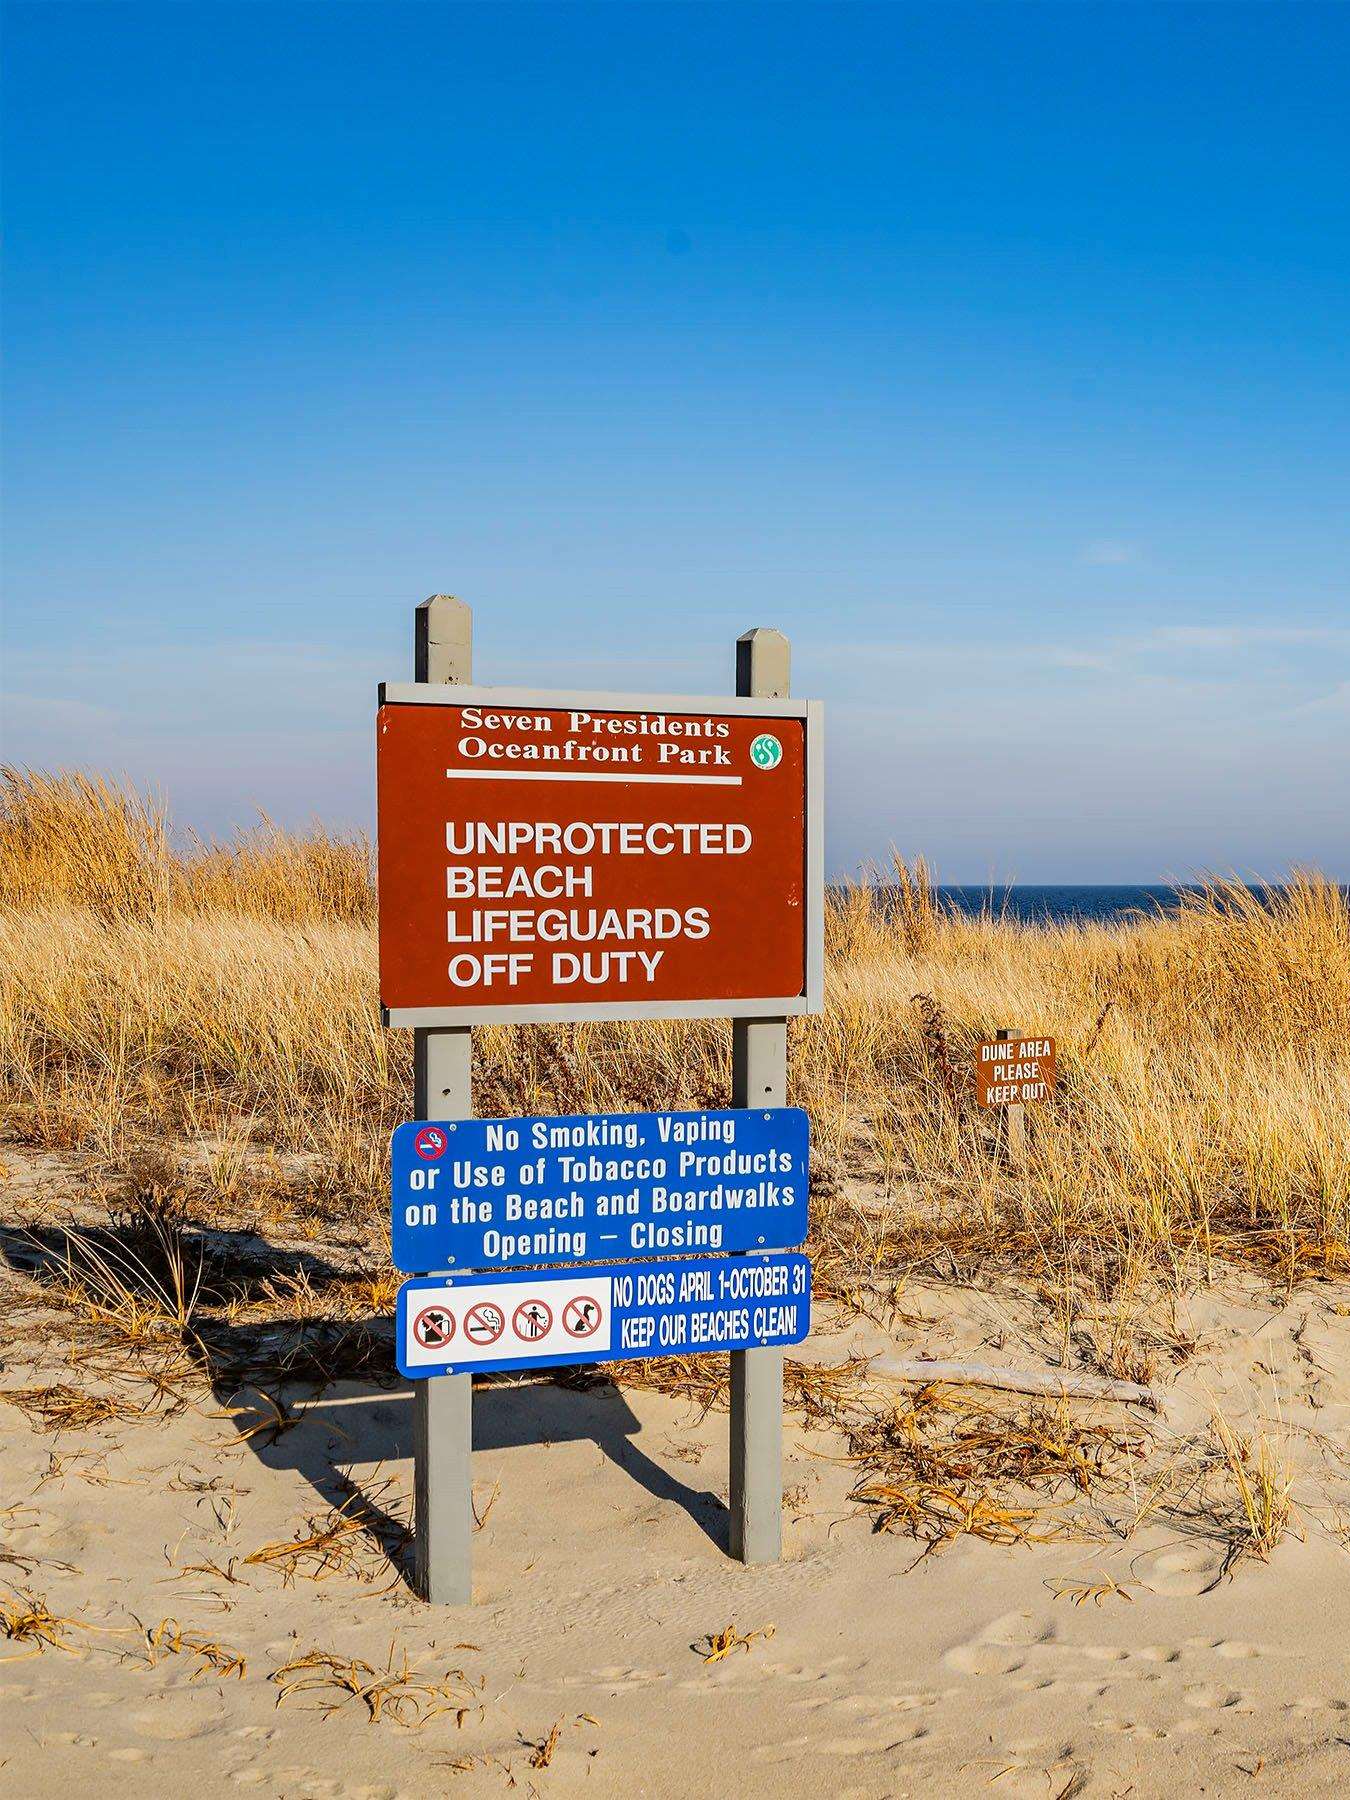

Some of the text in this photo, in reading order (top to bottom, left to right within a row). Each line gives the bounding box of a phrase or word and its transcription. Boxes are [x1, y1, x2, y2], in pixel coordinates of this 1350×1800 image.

[460, 708, 729, 737] Seven Presidents
[457, 737, 642, 763] Oceanfront
[658, 744, 731, 764] Park
[446, 822, 752, 854] UNPROTECTED
[447, 866, 592, 898] BEACH
[447, 908, 710, 942] LIFEGUARDS
[448, 951, 664, 987] OFF DUTY
[982, 1041, 1050, 1061] DUNE AREA
[994, 1062, 1038, 1081] PLEASE
[987, 1083, 1045, 1103] KEEP OUT
[487, 1117, 735, 1152] No Smoking, Vaping
[410, 1149, 792, 1190] or Use of Tobacco Products
[405, 1182, 794, 1227] on the Beach and Boardwalks
[483, 1228, 586, 1260] Opening
[631, 1222, 722, 1249] Closing
[613, 1267, 805, 1307] NO DOGS APRIL 1-OCTOBER 31
[622, 1306, 797, 1349] KEEP OUR BEACHES CLEAN!
